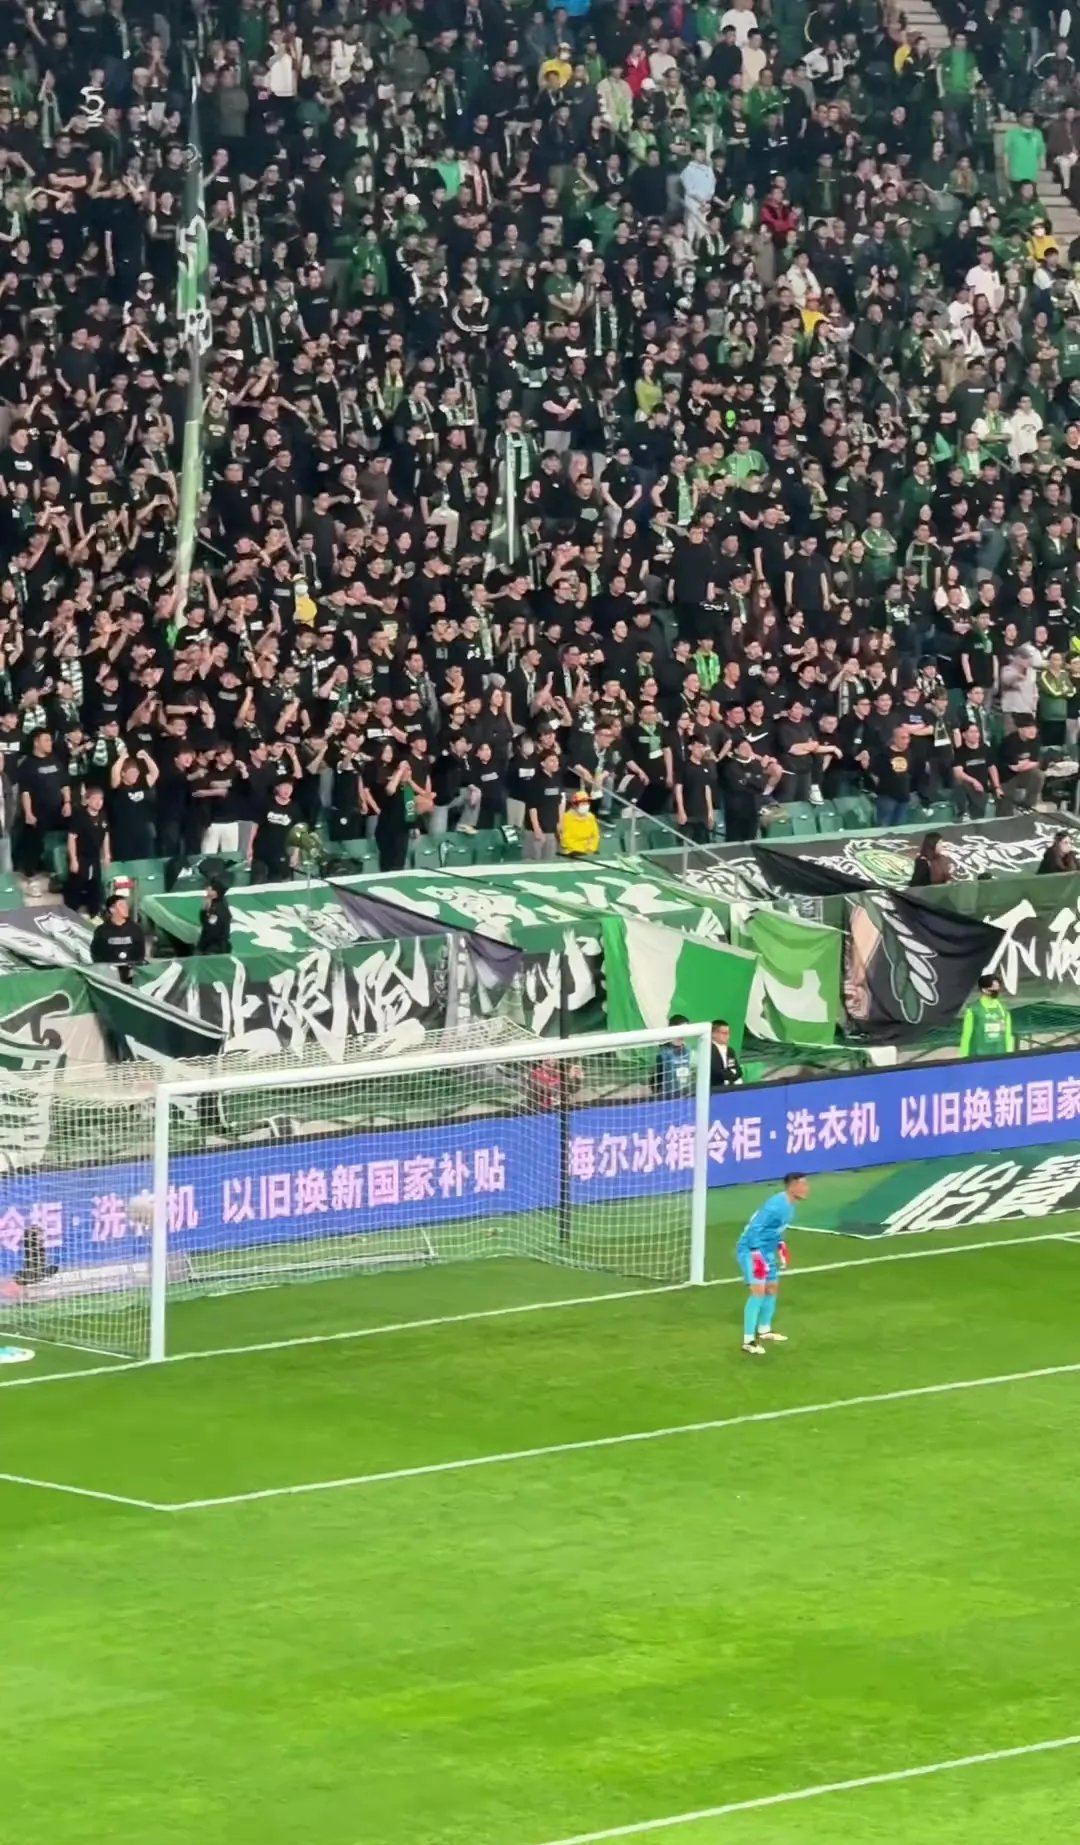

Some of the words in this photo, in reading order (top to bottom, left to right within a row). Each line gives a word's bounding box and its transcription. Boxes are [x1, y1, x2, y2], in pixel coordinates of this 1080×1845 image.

[222, 1146, 506, 1225] 以旧换新国家补贴
